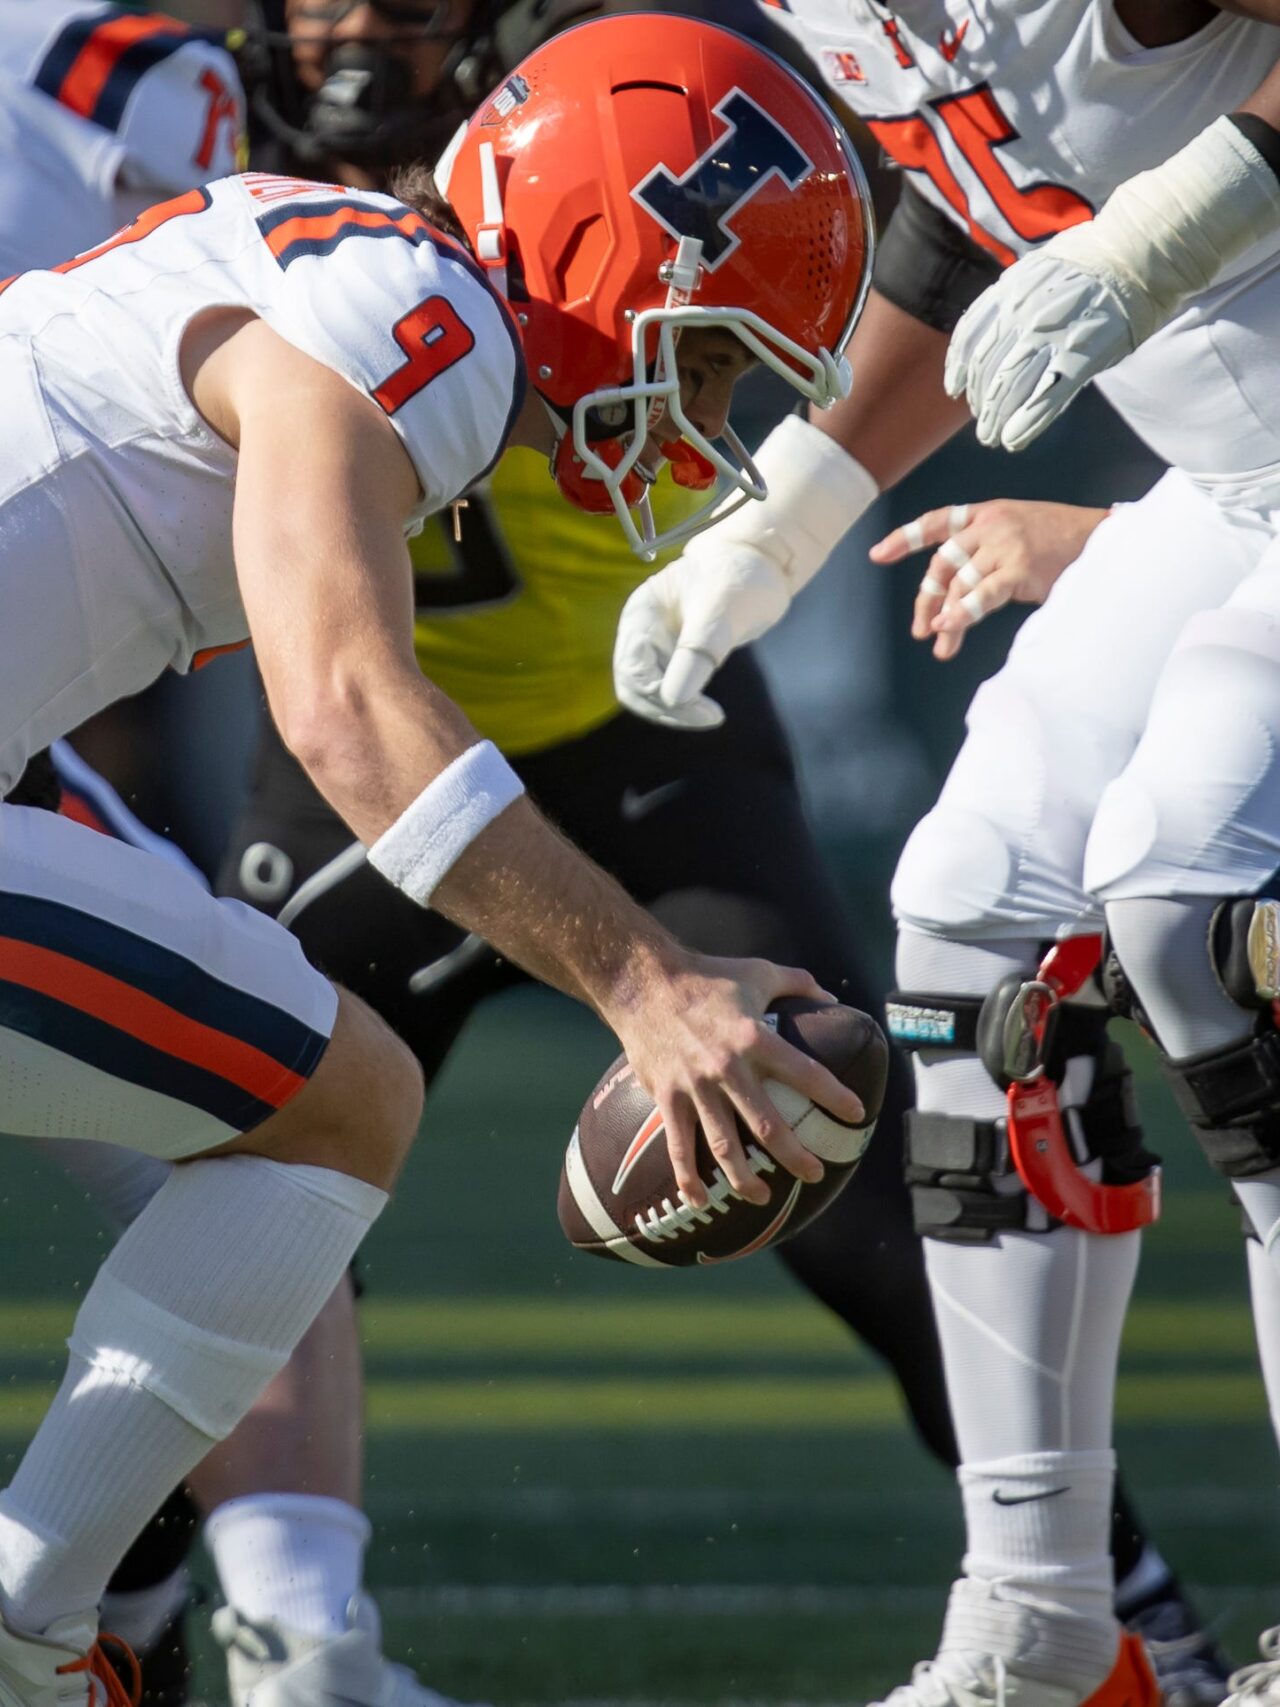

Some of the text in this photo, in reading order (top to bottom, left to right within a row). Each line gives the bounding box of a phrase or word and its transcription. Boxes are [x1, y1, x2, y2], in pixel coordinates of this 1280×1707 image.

[628, 85, 817, 274] I
[370, 295, 477, 417] 9
[239, 841, 294, 903] O
